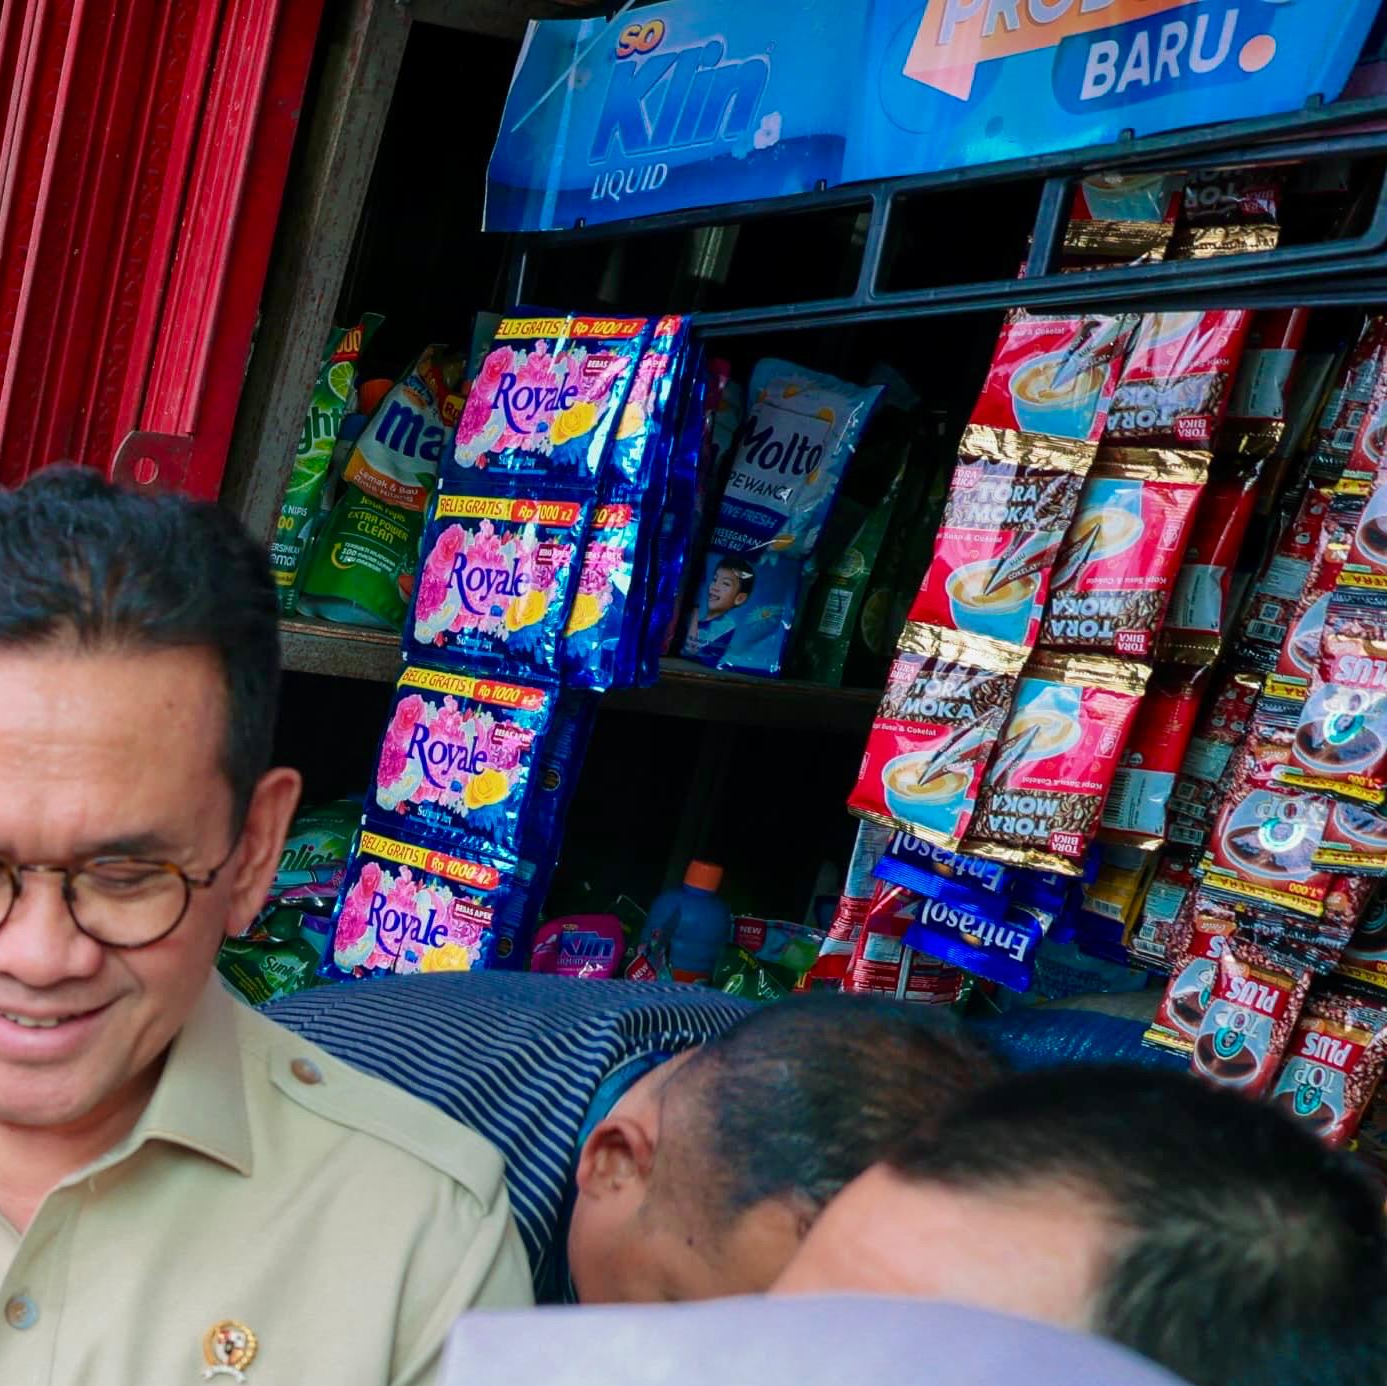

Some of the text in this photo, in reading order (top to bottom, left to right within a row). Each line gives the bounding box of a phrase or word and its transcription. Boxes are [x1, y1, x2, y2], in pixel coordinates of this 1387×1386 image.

[615, 18, 665, 60] SO
[587, 37, 771, 166] Klin
[591, 162, 669, 200] LIQUID
[519, 320, 562, 335] GRATIS
[573, 321, 588, 334] Rp
[587, 358, 609, 369] BEBAS
[491, 372, 578, 434] Royale
[1178, 416, 1207, 428] BIKA
[1178, 427, 1209, 438] TORA
[954, 469, 978, 479] TORA
[977, 484, 1038, 502] TORA
[440, 498, 458, 515] BELI
[465, 500, 503, 516] GRATIS
[517, 506, 535, 521] Rp
[536, 504, 560, 521] 1000
[561, 506, 574, 522] x2
[738, 506, 778, 529] FRESH
[967, 504, 1037, 524] MOKA
[347, 511, 410, 543] EXTRA POWER
[357, 520, 396, 545] CLEAN
[974, 534, 1004, 543] Cokelat
[446, 552, 530, 616] Royale
[1147, 575, 1168, 585] Kopi
[1051, 597, 1121, 617] MOKA
[1051, 620, 1115, 639] TORA
[1119, 632, 1146, 643] BIKA
[1116, 642, 1146, 653] TORA
[893, 662, 916, 674] TORA
[402, 669, 422, 684] BELI
[427, 673, 467, 694] GRATIS
[477, 685, 492, 699] Rp
[491, 686, 522, 702] 1000
[914, 678, 974, 700] TORA
[901, 697, 977, 719] MOKA
[906, 725, 937, 737] Cokelat
[405, 722, 489, 790] Royale
[1022, 775, 1053, 786] Cokelat
[1082, 781, 1103, 791] Kopi
[992, 794, 1062, 817] MOKA
[988, 815, 1051, 838] TORA
[1050, 841, 1080, 854] TORA
[1053, 833, 1080, 844] BIKA
[361, 834, 380, 850] BELI
[379, 839, 388, 853] 3
[386, 841, 421, 864] GRATIS
[431, 857, 445, 872] Rp
[446, 858, 476, 879] 1000
[454, 902, 493, 921] BEBAS APEK
[365, 890, 449, 958] Royale
[739, 925, 763, 936] NEW
[920, 898, 1031, 964] Entrasol
[560, 931, 616, 958] Klin
[632, 963, 649, 981] NEW
[1226, 976, 1280, 1013] PLUS
[1215, 1007, 1261, 1039] TOP
[1301, 1031, 1354, 1068] PLUS
[1294, 1062, 1335, 1094] TOP
